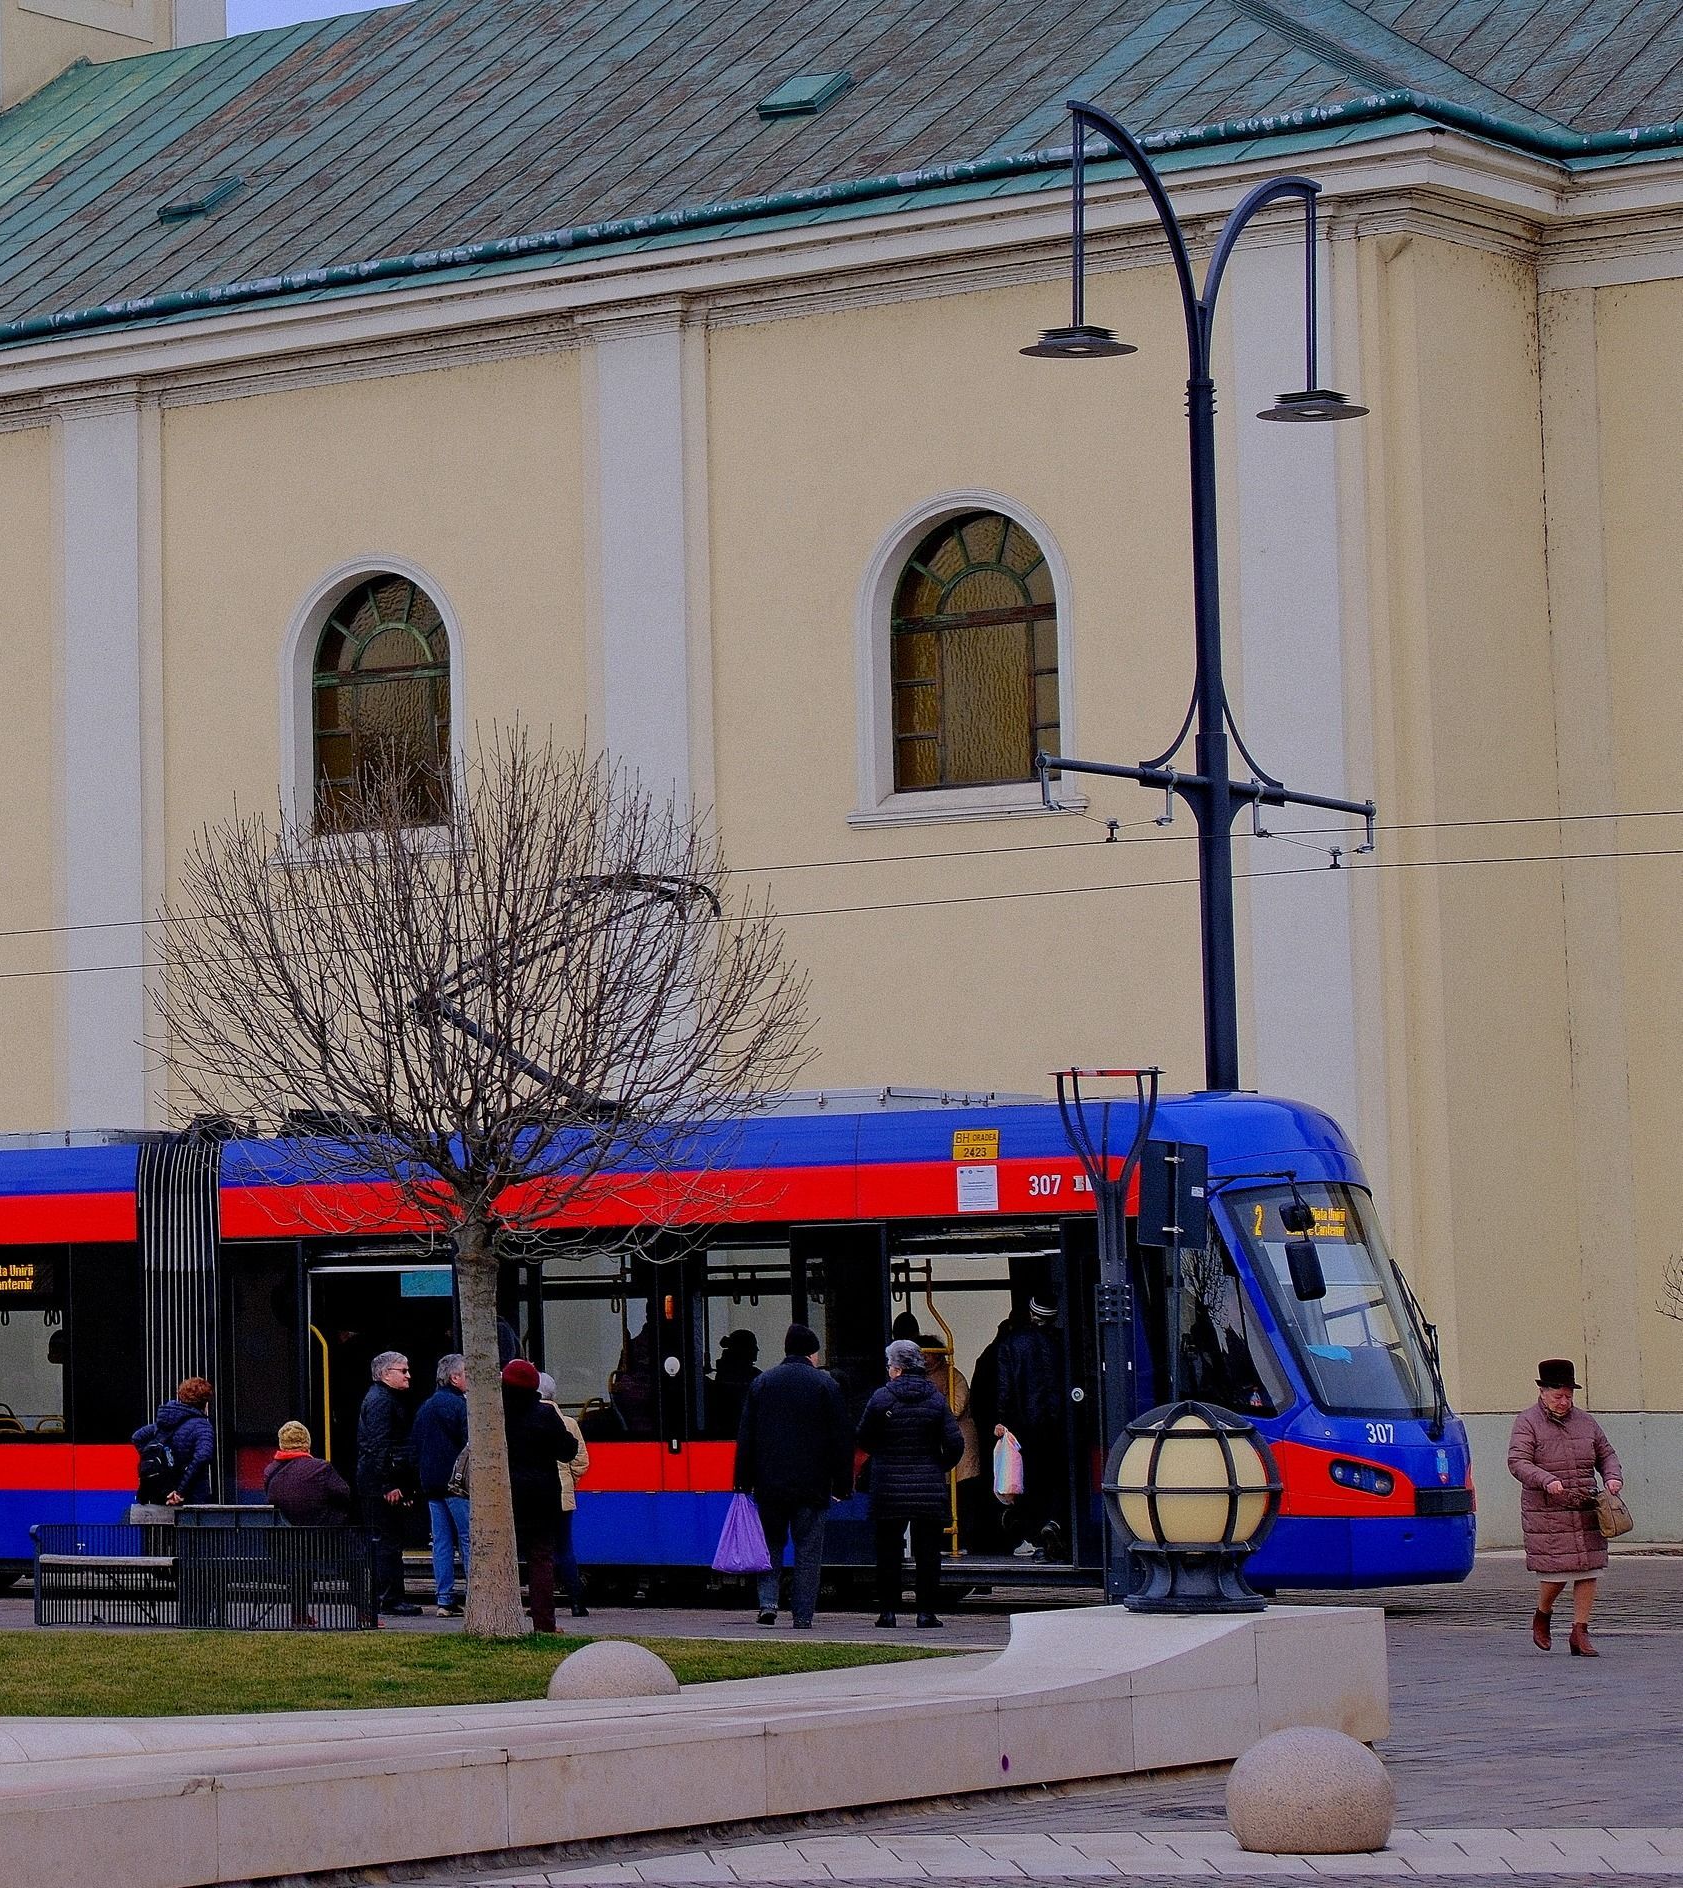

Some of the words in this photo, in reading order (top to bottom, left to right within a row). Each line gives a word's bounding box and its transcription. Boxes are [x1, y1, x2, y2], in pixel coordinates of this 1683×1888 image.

[955, 1133, 970, 1144] BH
[972, 1134, 997, 1142] ORADEA
[963, 1147, 987, 1158] 2423
[1028, 1174, 1062, 1196] 307
[1254, 1204, 1263, 1236] 2
[9, 1263, 34, 1277] Unirii
[1365, 1422, 1394, 1444] 307
